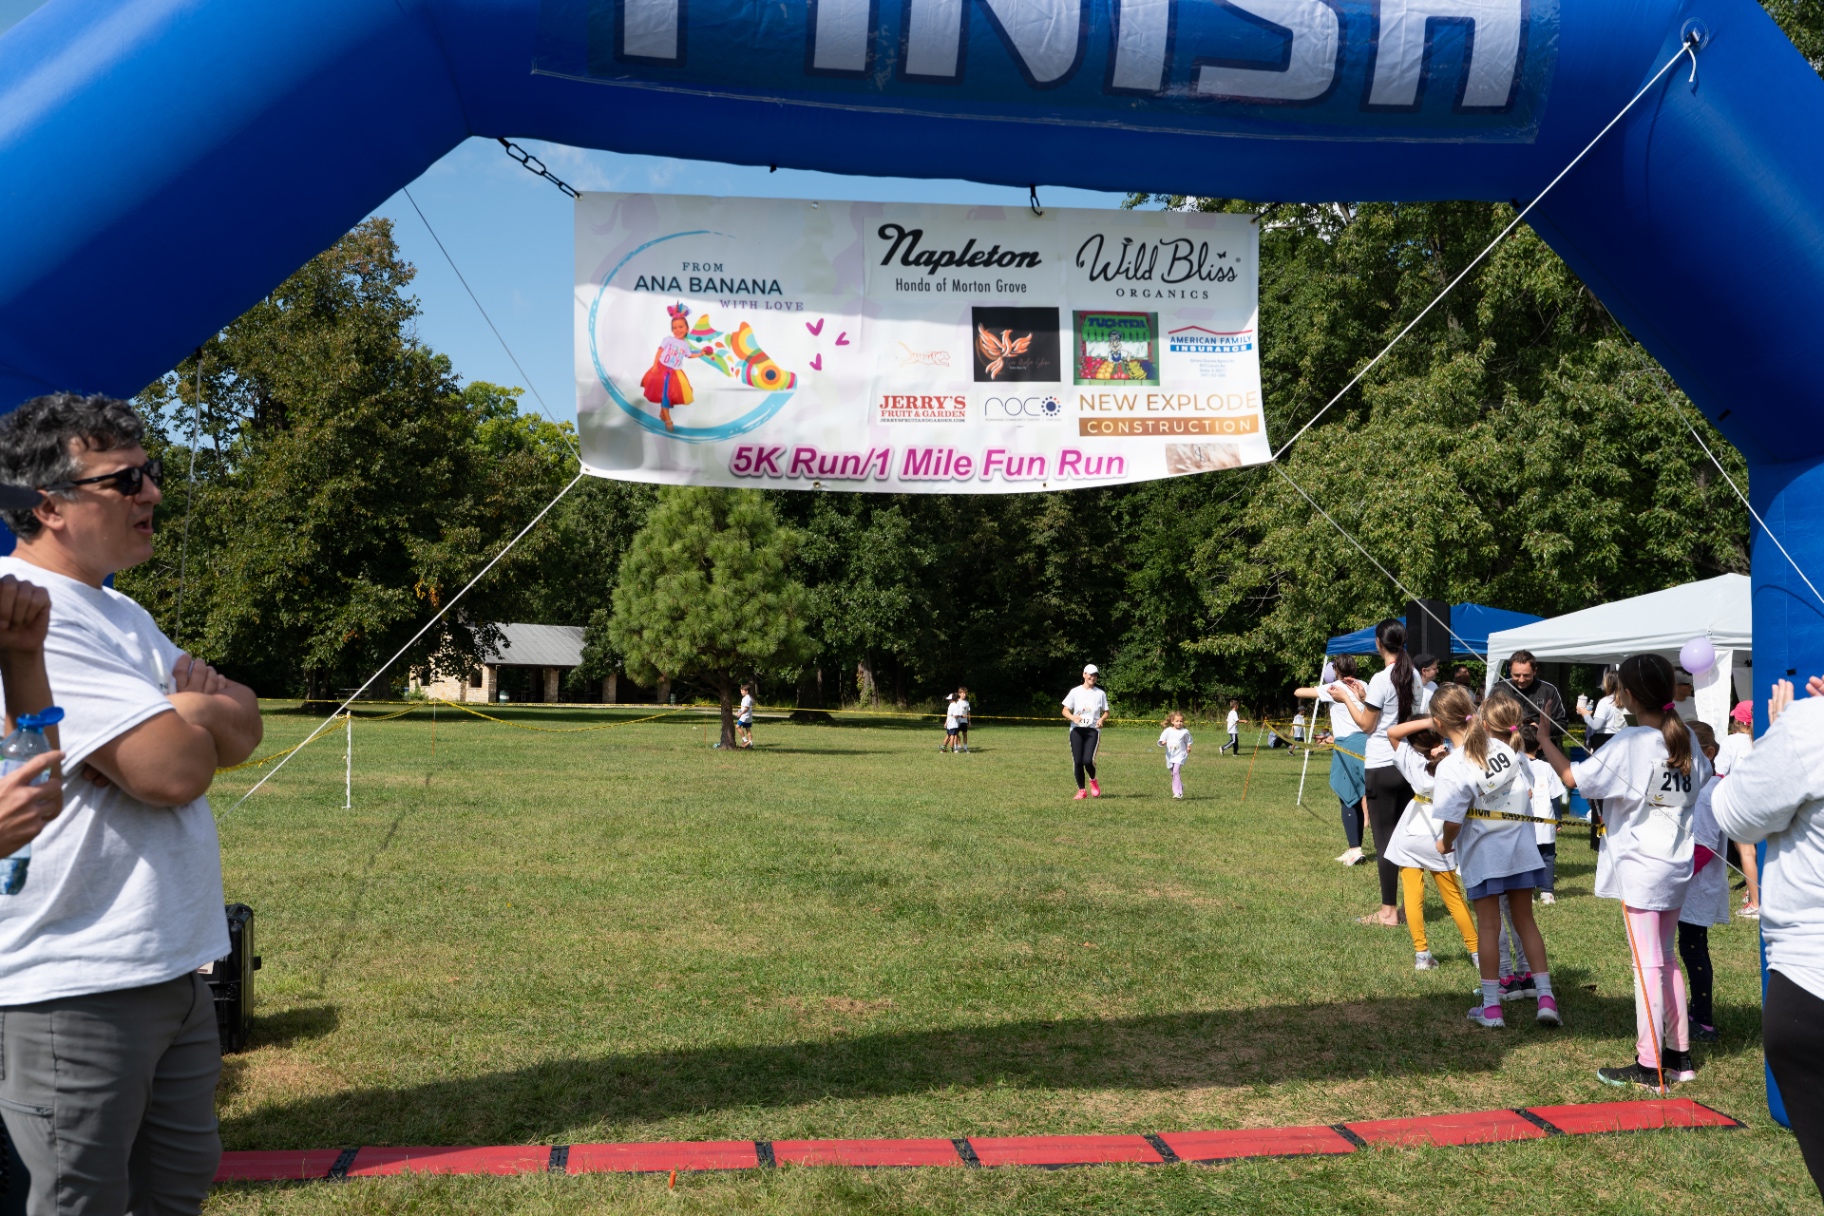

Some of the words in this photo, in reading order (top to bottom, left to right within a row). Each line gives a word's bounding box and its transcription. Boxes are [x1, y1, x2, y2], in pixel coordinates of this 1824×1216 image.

[877, 223, 1042, 275] Napleton
[1075, 233, 1159, 282] Wild
[1159, 237, 1238, 284] Bliss
[681, 261, 724, 272] FROM
[633, 275, 682, 292] ANA
[688, 277, 782, 296] BANANA
[895, 277, 931, 292] Honda
[936, 278, 947, 292] of
[952, 279, 991, 293] Morton
[996, 279, 1027, 294] Grove
[1115, 287, 1209, 300] ORGANICS
[719, 299, 760, 310] WITH
[765, 300, 804, 311] LOVE
[1170, 335, 1217, 345] AMERICAN
[1220, 334, 1252, 345] FAMILY
[1175, 344, 1247, 353] INSURANCE
[879, 395, 966, 409] JERRY'S
[1080, 393, 1138, 411] NEW
[1147, 391, 1258, 411] EXPLODE
[881, 410, 913, 418] FRUIT
[914, 410, 921, 418] &
[922, 410, 966, 418] GARDEN
[1087, 419, 1251, 433] CONSTRUCTION
[733, 446, 782, 474] 5K
[790, 447, 889, 477] Run/1
[902, 449, 972, 477] Mile
[983, 449, 1047, 477] Fun
[1057, 449, 1125, 477] Run
[1660, 771, 1692, 793] 218
